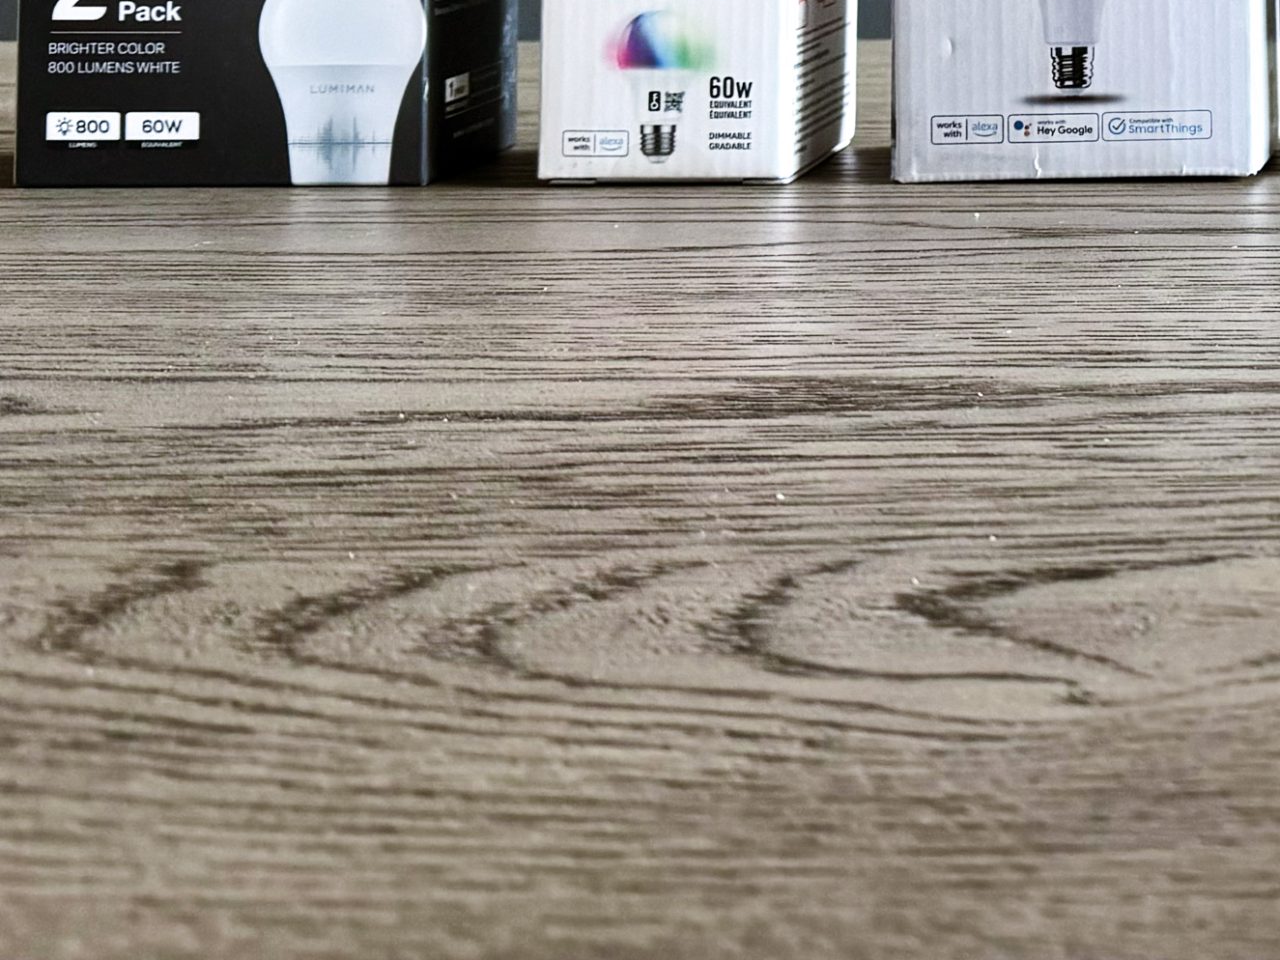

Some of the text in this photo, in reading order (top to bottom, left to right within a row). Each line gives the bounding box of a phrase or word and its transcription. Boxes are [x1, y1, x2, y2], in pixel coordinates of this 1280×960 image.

[118, 0, 182, 21] Pack
[48, 42, 165, 55] BRIGHTER COLOR
[48, 61, 181, 73] 800 LUMENS WHITE
[76, 120, 110, 133] 800
[142, 120, 183, 133] 60W
[937, 121, 962, 129] works
[971, 122, 998, 131] alexa
[1037, 124, 1093, 136] Hey Google
[1129, 123, 1203, 136] SmartThings
[709, 132, 752, 140] DIMMABLE
[944, 129, 962, 138] with
